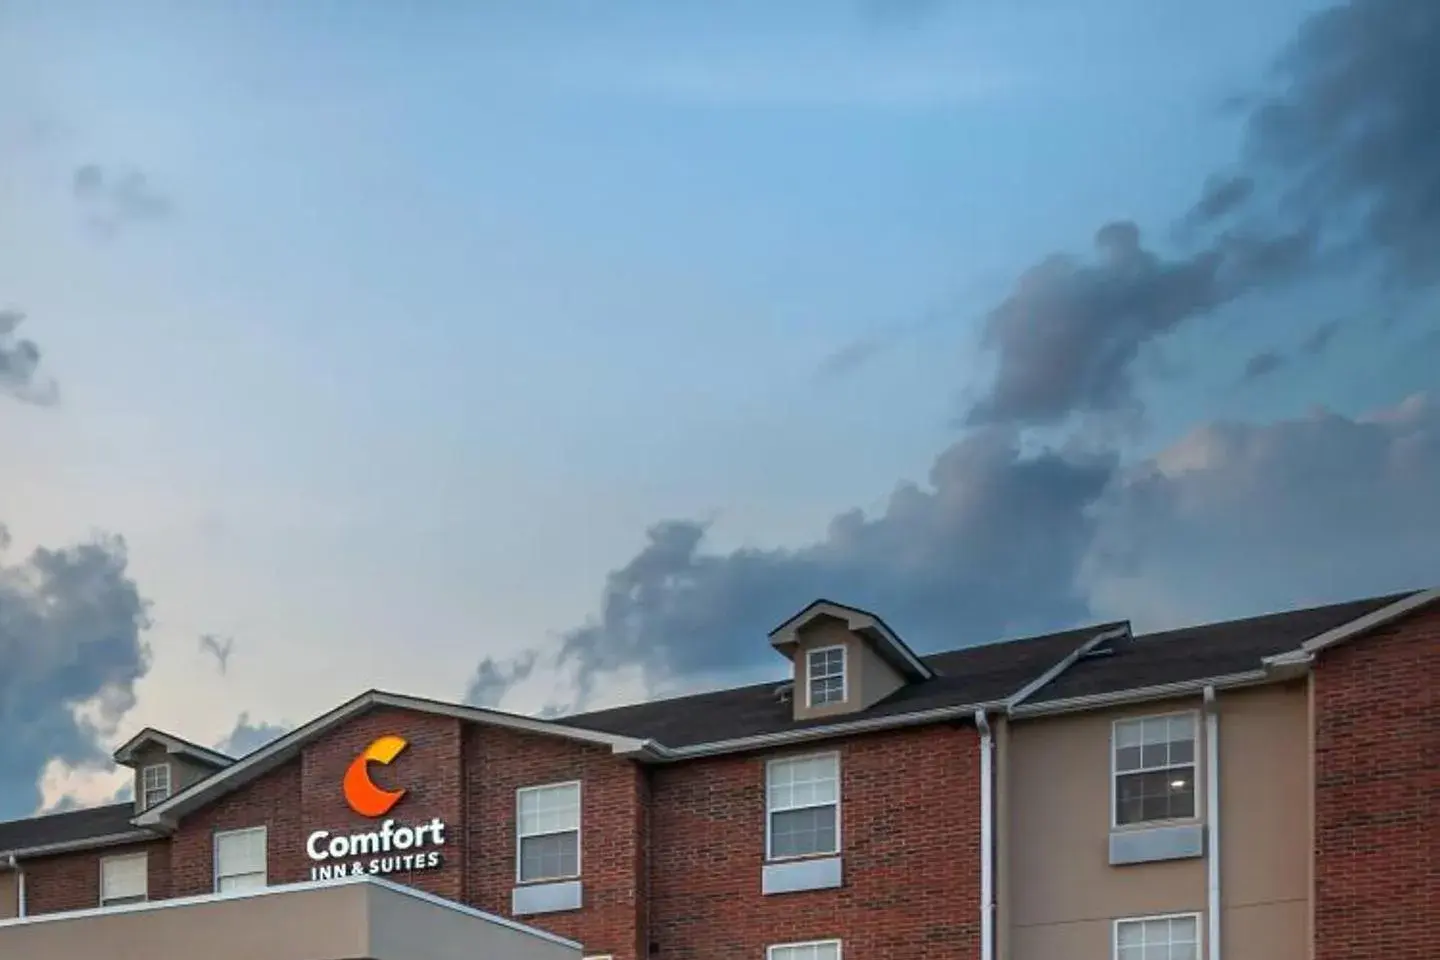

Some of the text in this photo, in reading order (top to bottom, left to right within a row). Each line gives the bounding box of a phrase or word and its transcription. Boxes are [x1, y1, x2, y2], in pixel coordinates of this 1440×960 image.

[307, 818, 445, 860] Comfort
[312, 852, 440, 881] INN & SUITES
